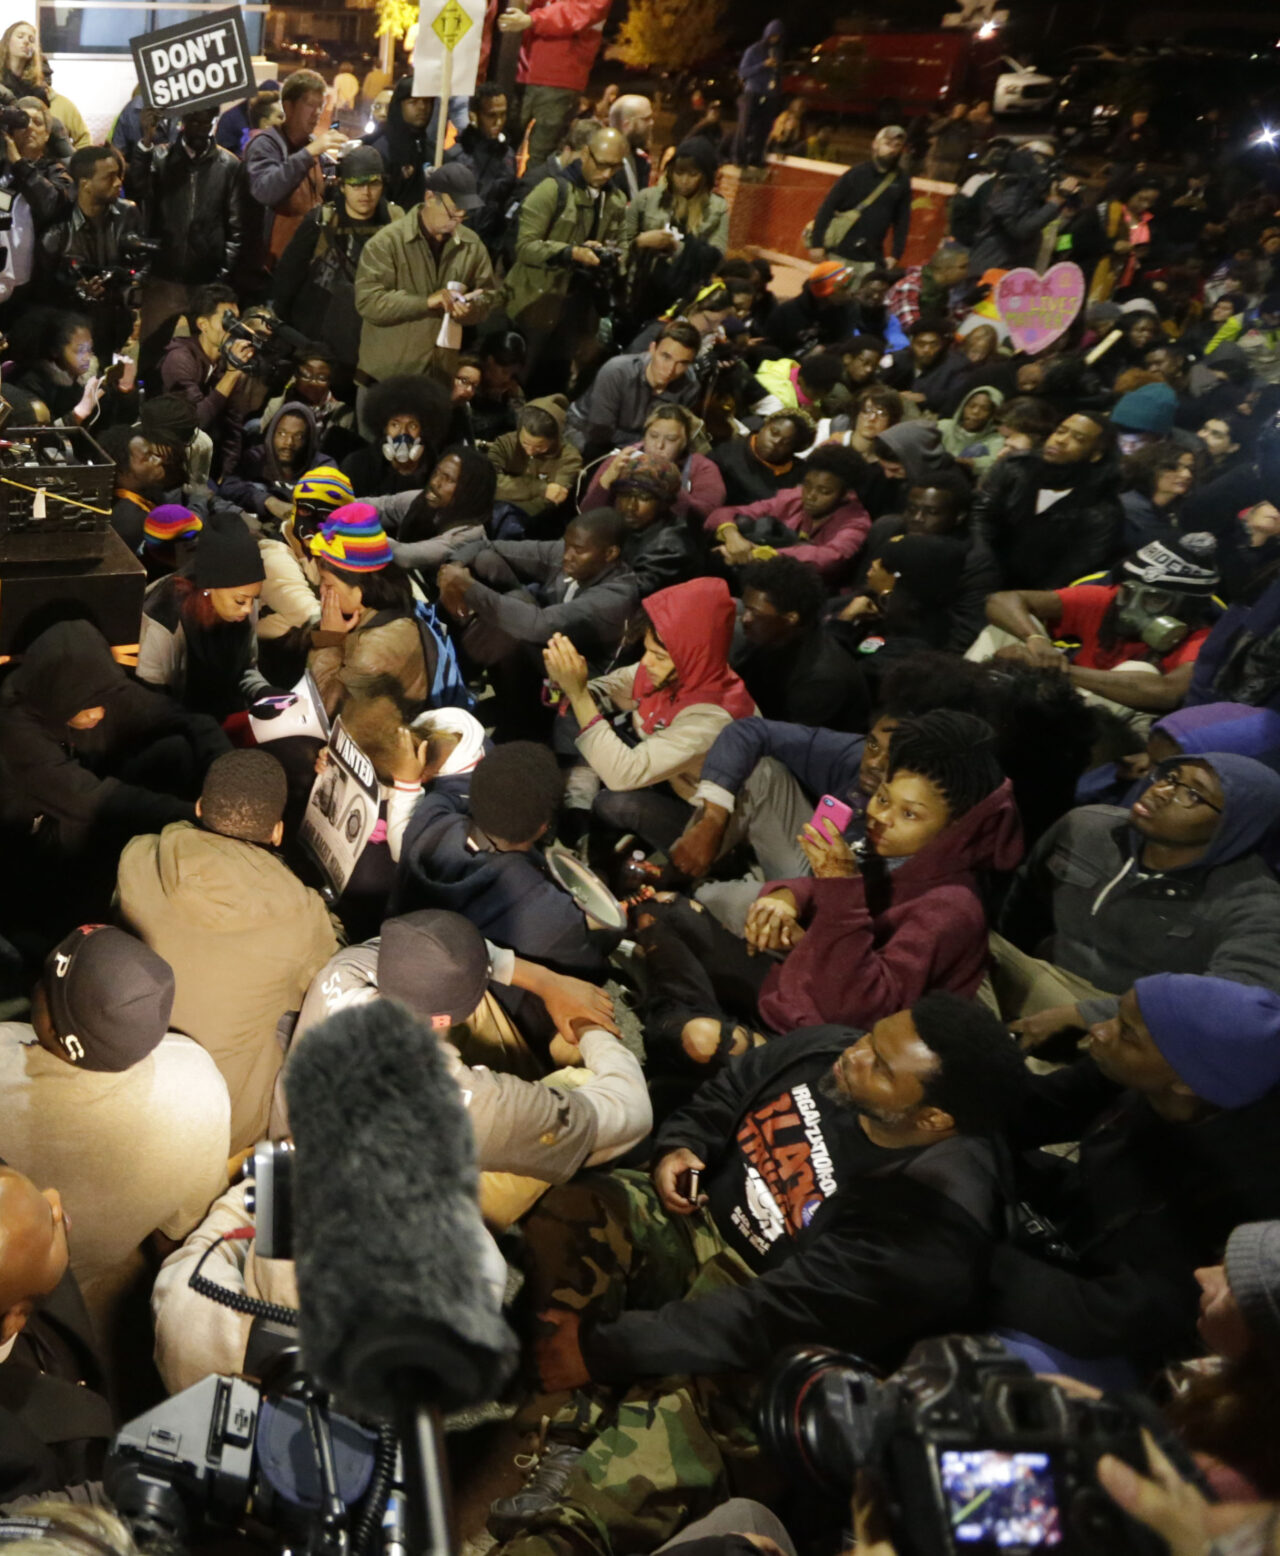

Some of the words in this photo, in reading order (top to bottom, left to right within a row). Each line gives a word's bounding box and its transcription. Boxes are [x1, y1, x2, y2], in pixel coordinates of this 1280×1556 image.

[151, 29, 226, 76] DON'T
[153, 56, 238, 105] SHOOT
[1000, 279, 1053, 298] BLACK
[335, 727, 374, 787] WANTED
